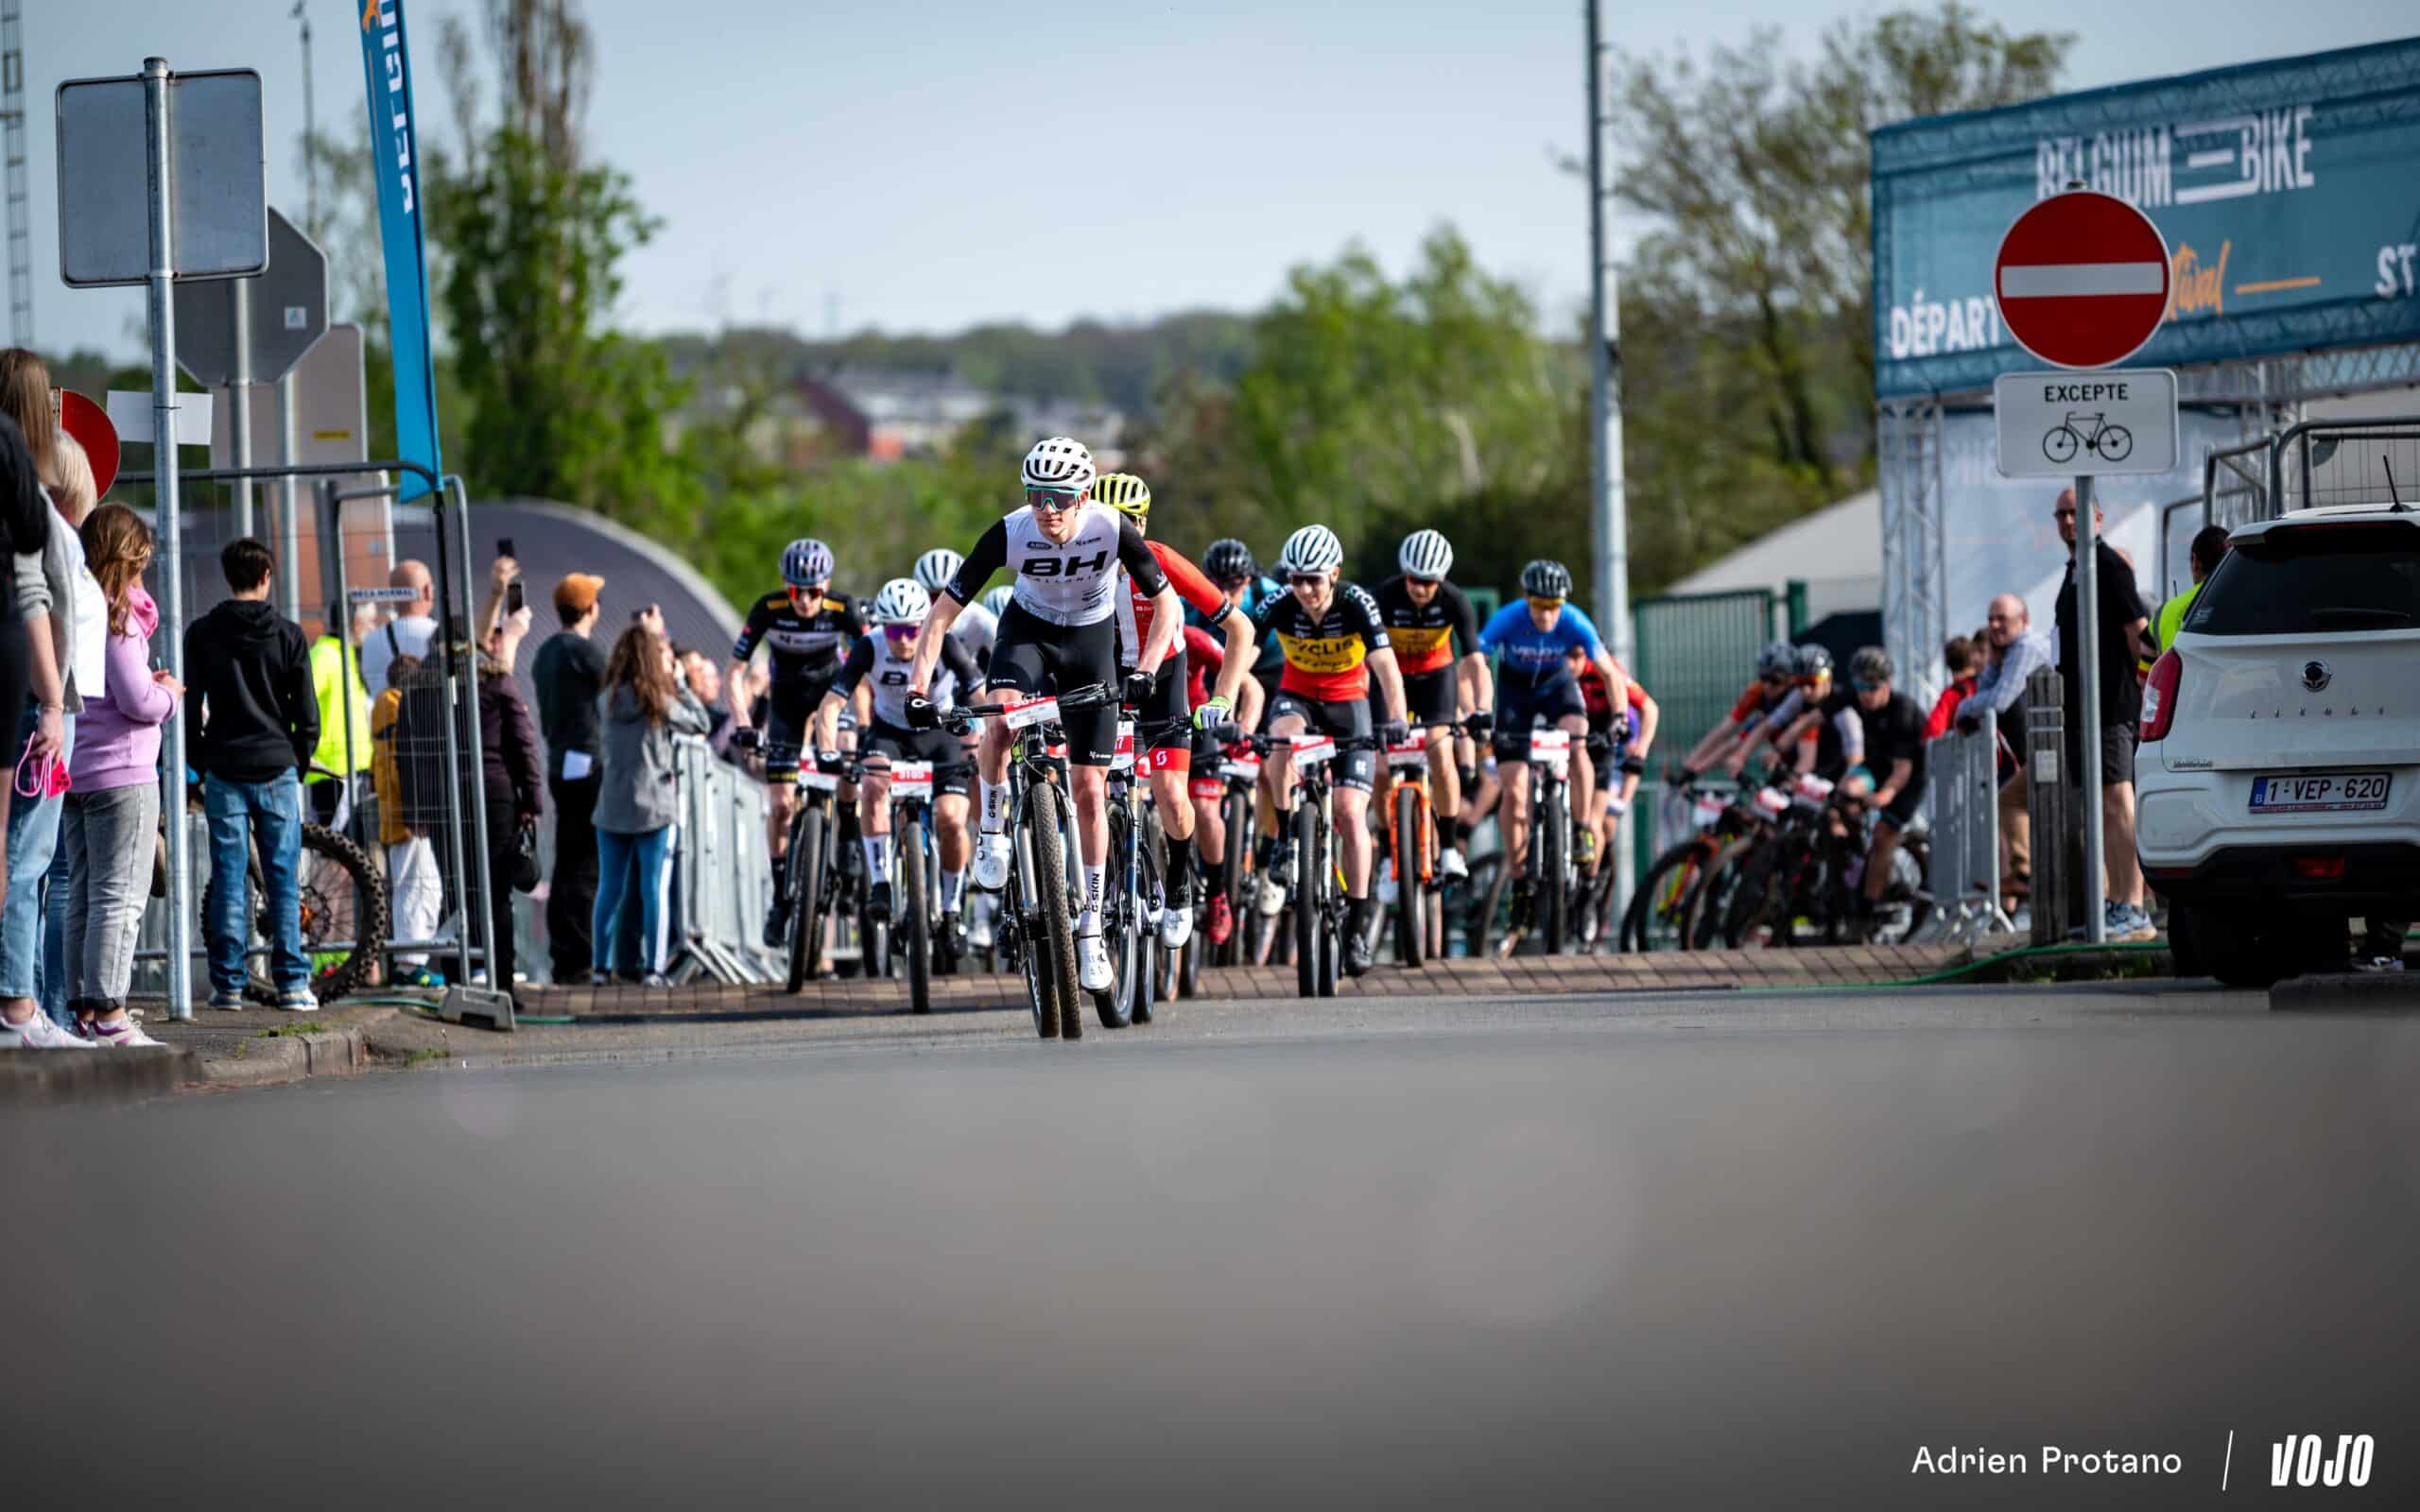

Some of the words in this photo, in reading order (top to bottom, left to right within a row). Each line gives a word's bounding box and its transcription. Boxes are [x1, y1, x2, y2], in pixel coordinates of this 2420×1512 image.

[2036, 124, 2172, 208] BELGIUM
[2241, 106, 2315, 193] BIKE
[2164, 239, 2231, 322] tival
[1892, 288, 1999, 359] DÉPART
[2044, 384, 2129, 403] EXCEPTE
[1020, 550, 1108, 576] BH
[1350, 584, 1382, 627] CYCLIS
[1091, 872, 1100, 913] G-SKIN
